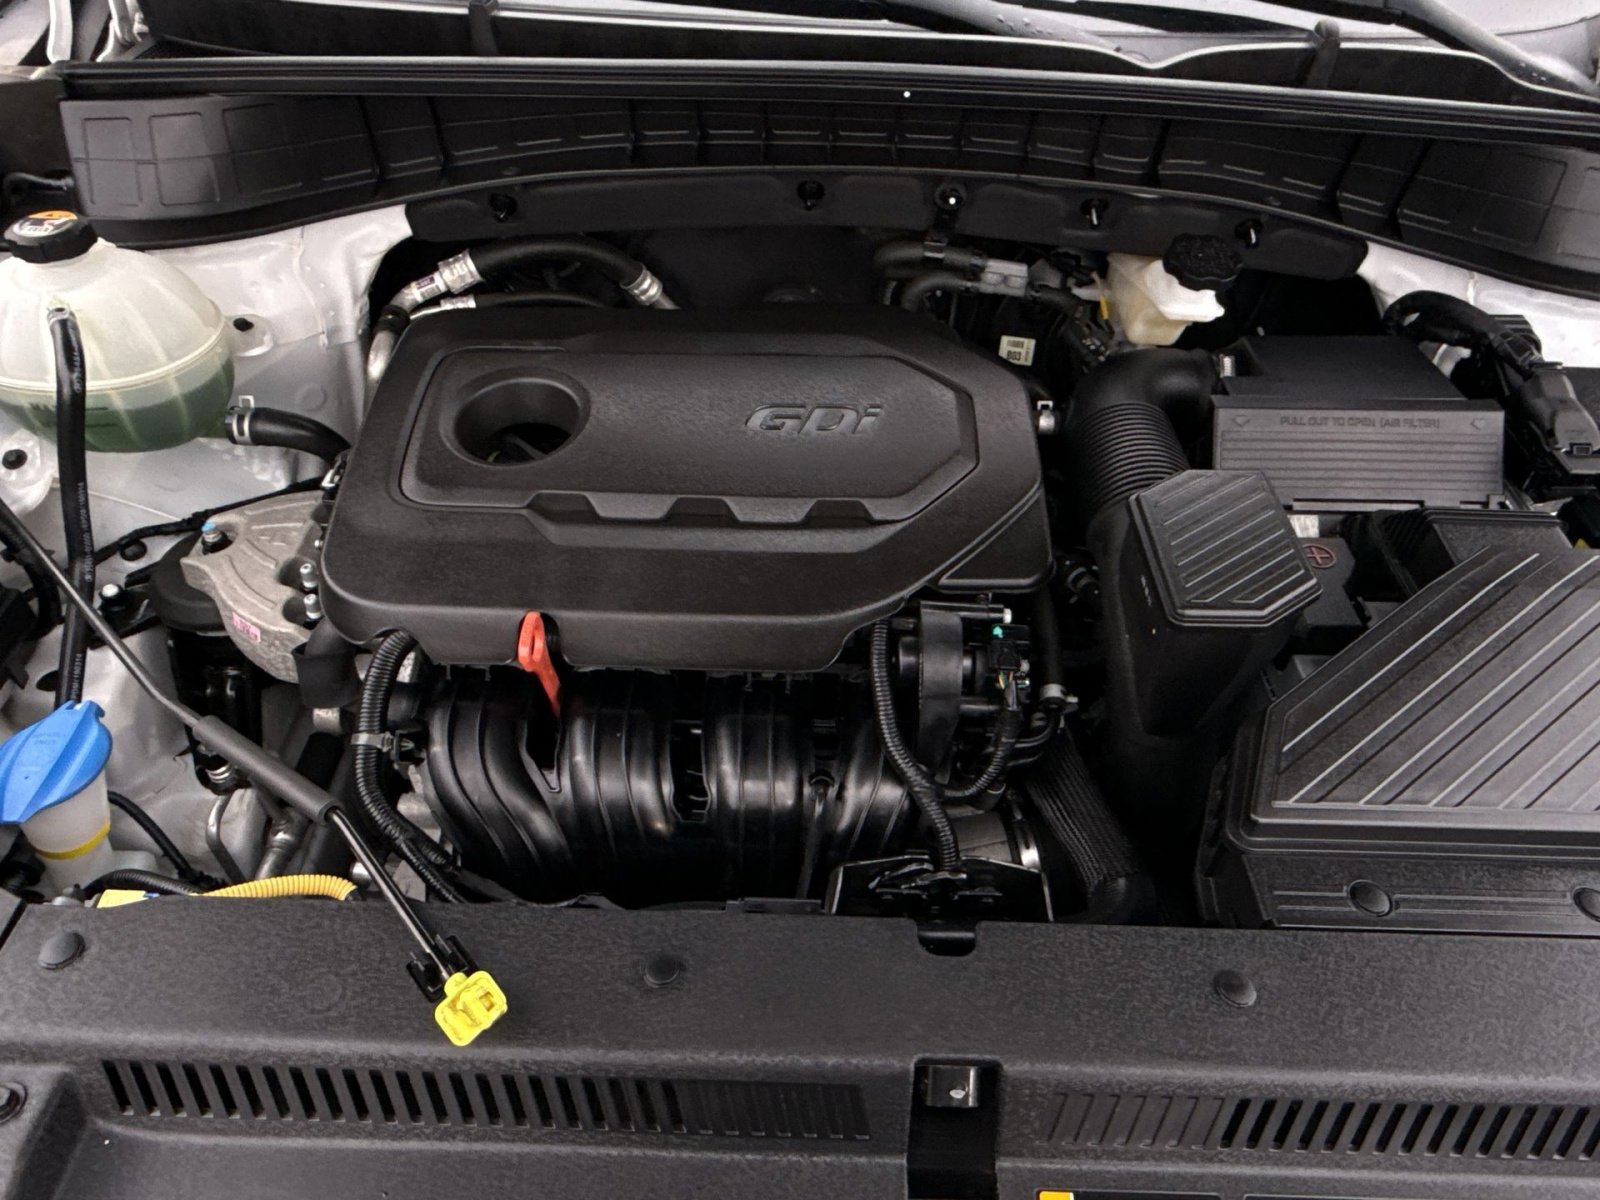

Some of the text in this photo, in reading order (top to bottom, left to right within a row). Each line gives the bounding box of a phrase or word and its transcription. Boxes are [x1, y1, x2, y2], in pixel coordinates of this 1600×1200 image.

[1280, 416, 1306, 426] PULL
[1308, 416, 1328, 426] OUT
[1332, 416, 1345, 426] TO
[1346, 416, 1376, 427] OPEN
